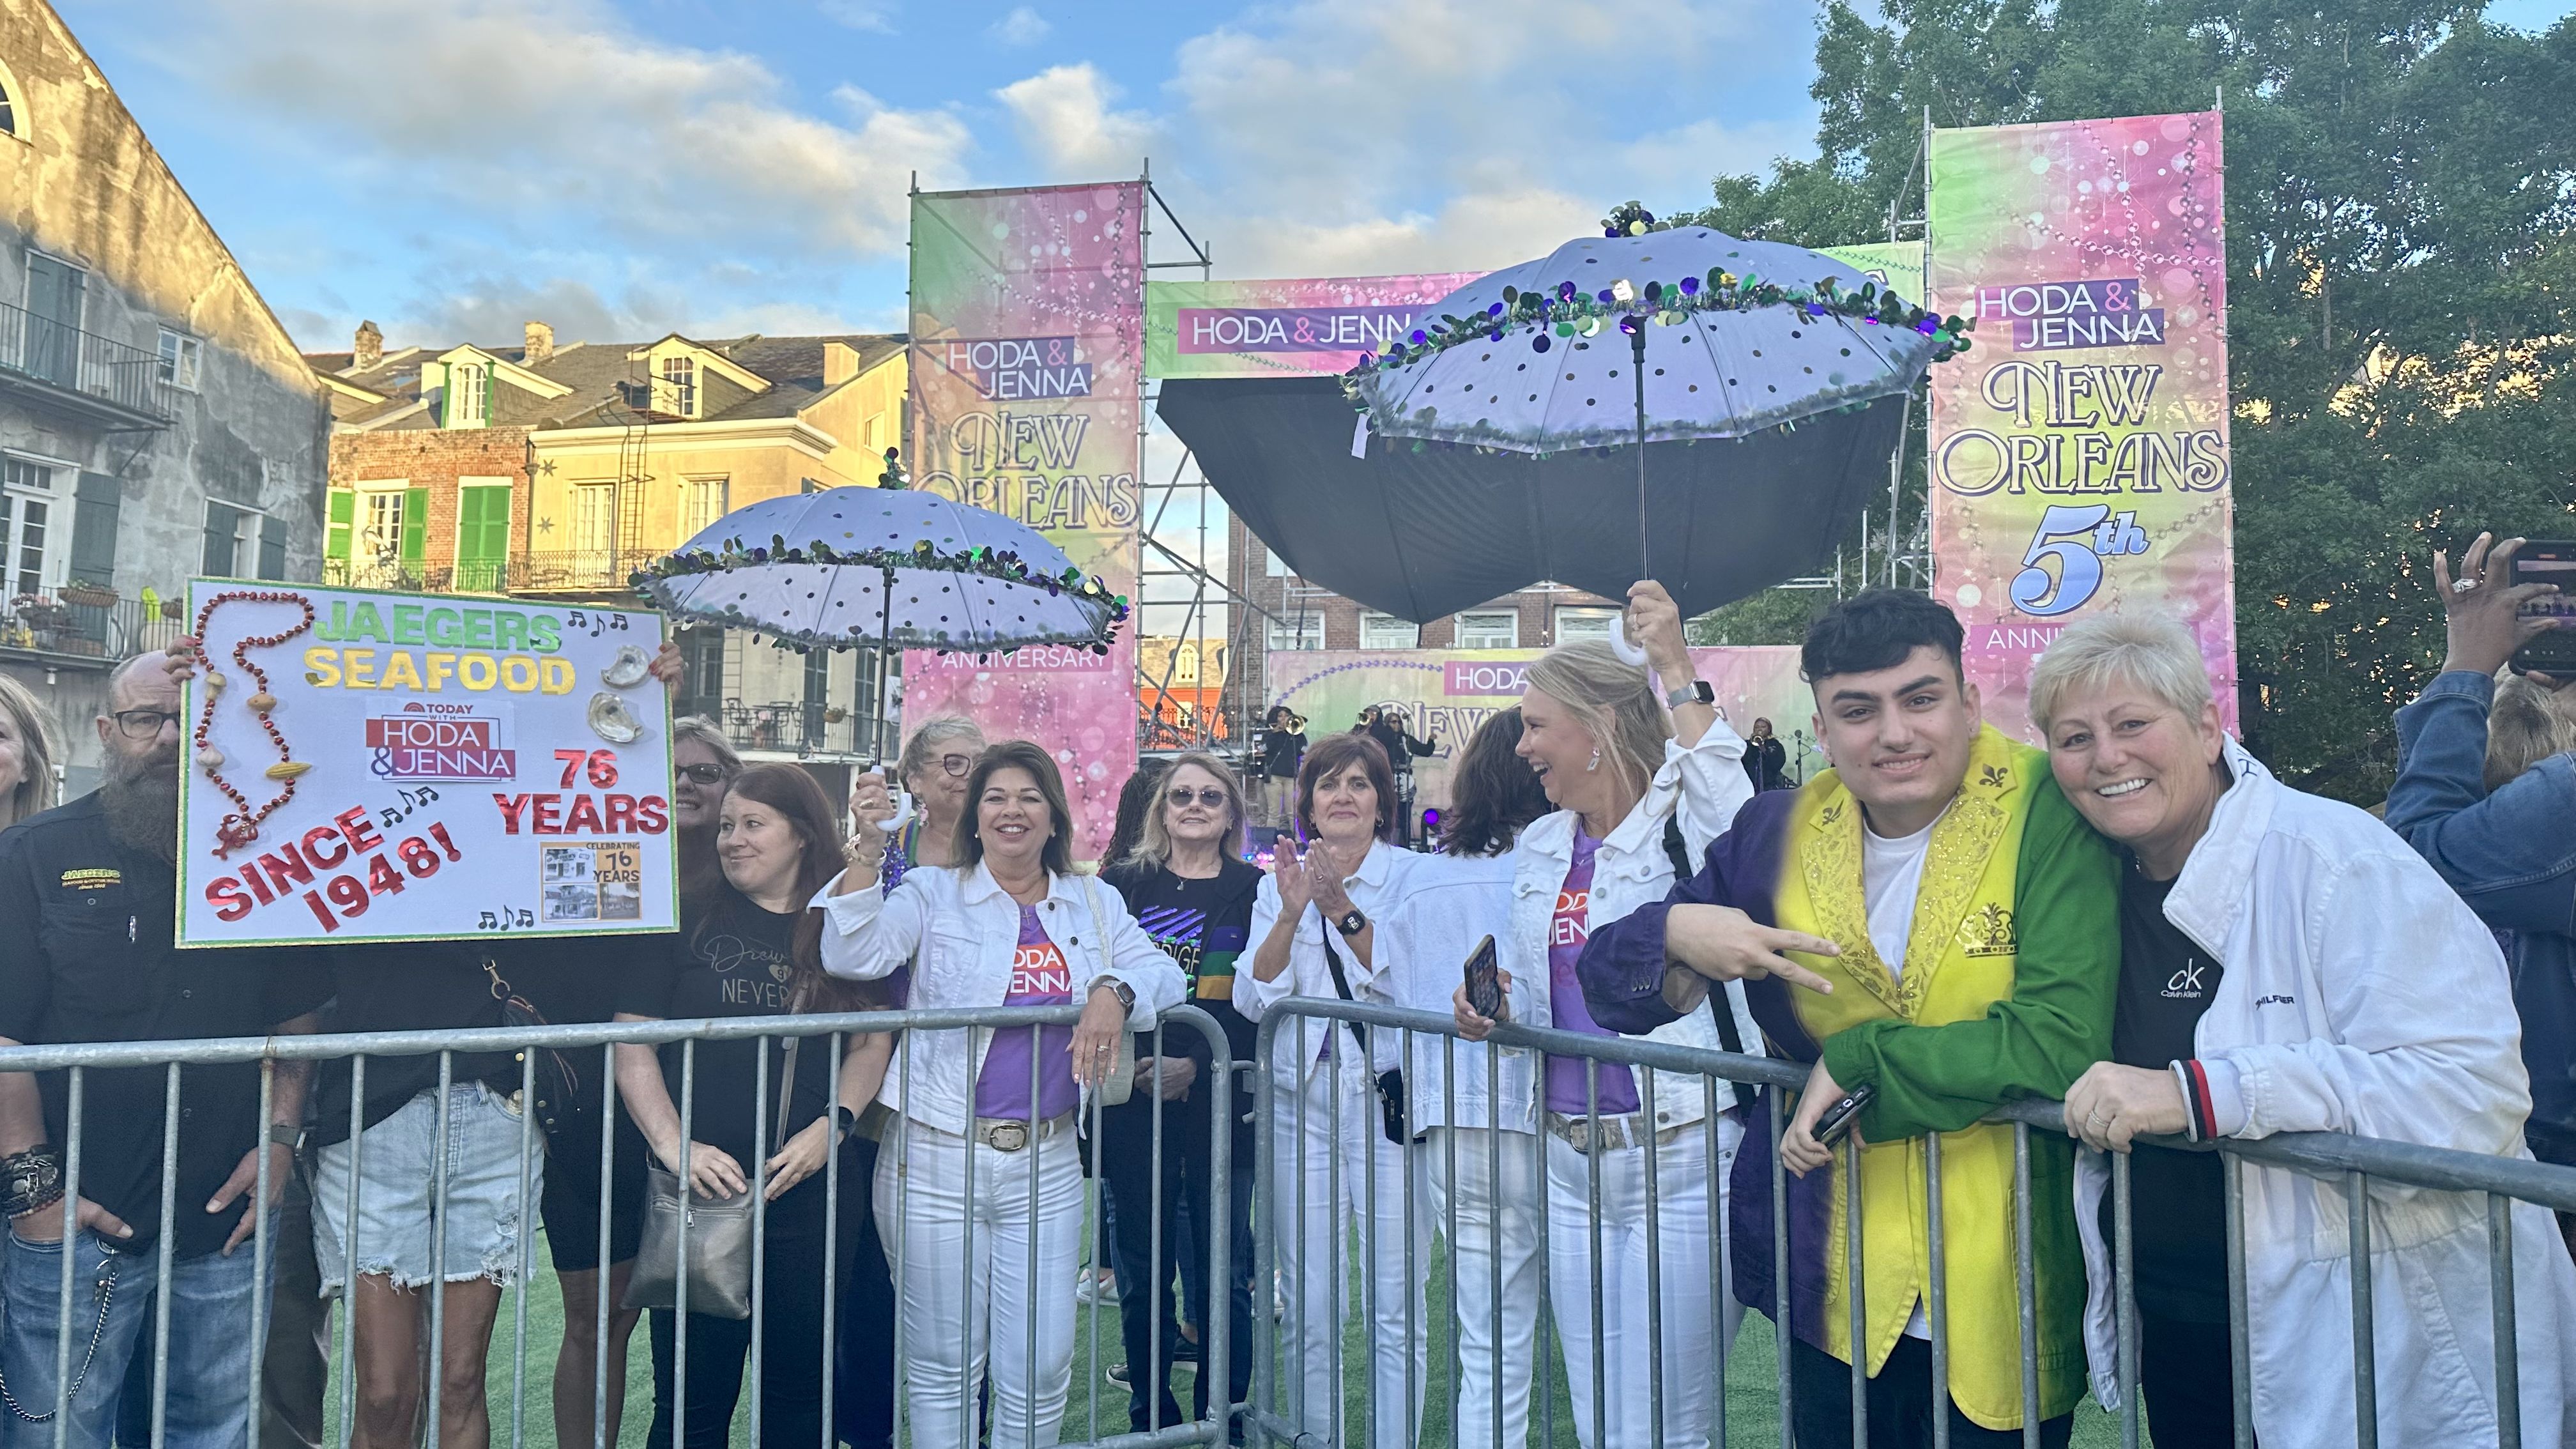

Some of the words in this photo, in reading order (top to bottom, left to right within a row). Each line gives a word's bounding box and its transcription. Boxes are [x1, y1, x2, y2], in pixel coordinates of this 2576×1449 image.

[1979, 283, 2098, 318] HODA
[2104, 282, 2131, 310] &
[1193, 316, 1289, 345] HODA
[1294, 316, 1315, 344] &
[1319, 313, 1411, 344] JENN
[2019, 312, 2162, 348] JENNA
[949, 339, 1041, 370] HODA
[1046, 339, 1068, 366] &
[981, 366, 1090, 400] JENNA
[1980, 361, 2163, 428] NEW
[949, 410, 1091, 471] NEW
[1935, 429, 2227, 498] ORLEANS
[2009, 504, 2149, 617] 5th
[313, 600, 561, 654] JAEGERS
[303, 646, 576, 696] SEAFOOD
[941, 648, 1105, 668] ANNIVERSARY
[1456, 667, 1529, 690] HODA
[426, 703, 473, 714] TODAY
[384, 721, 480, 747] HODA
[371, 746, 393, 776] &
[396, 749, 511, 775] JENNA
[553, 749, 618, 789] 76
[493, 793, 669, 836] YEARS
[204, 804, 385, 923] SINCE
[303, 821, 463, 934] 1948!
[593, 870, 640, 882] YEARS
[605, 850, 632, 870] 76
[722, 978, 791, 1008] NEVER
